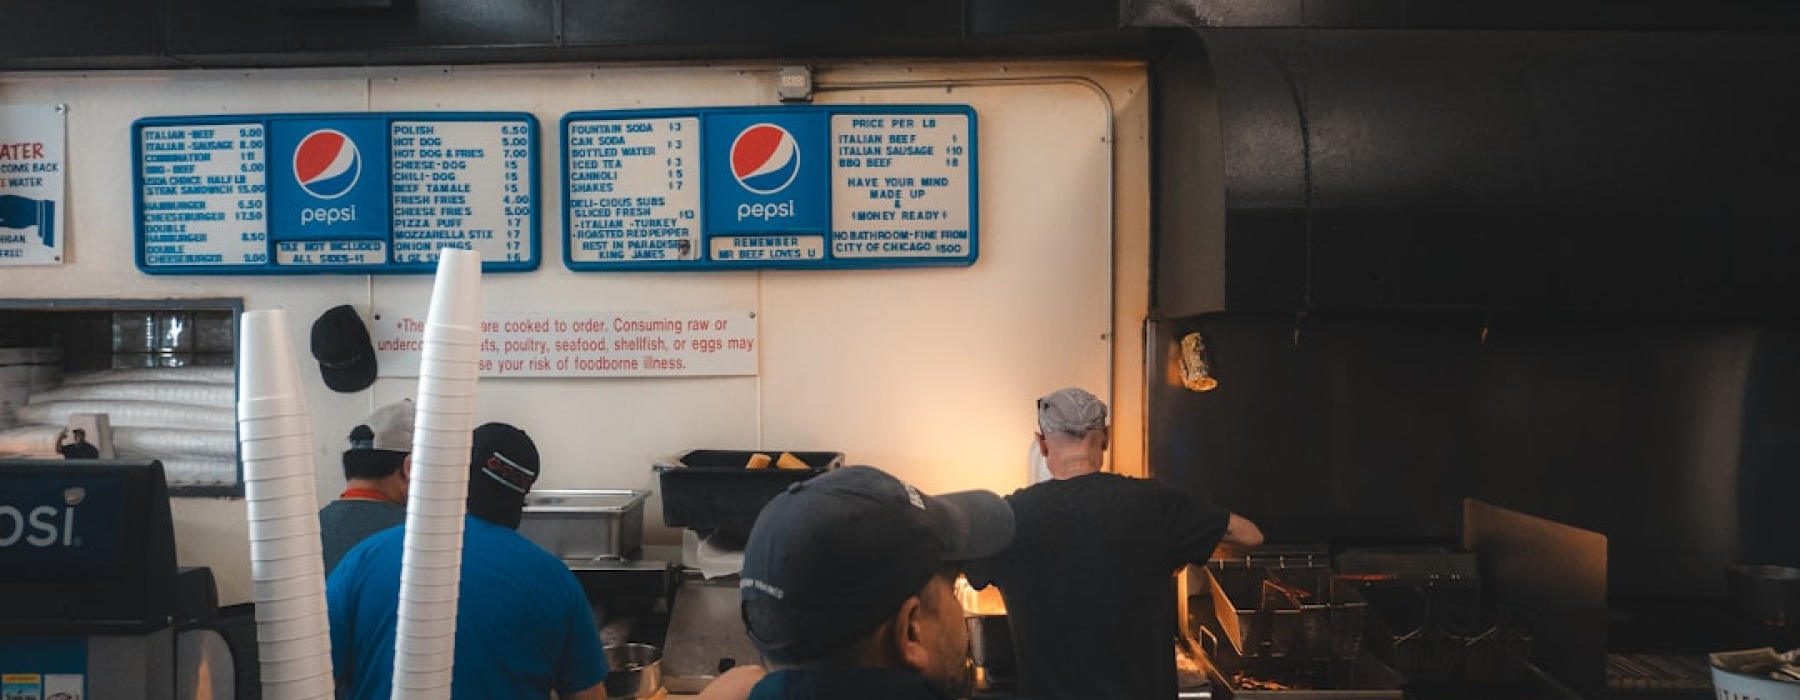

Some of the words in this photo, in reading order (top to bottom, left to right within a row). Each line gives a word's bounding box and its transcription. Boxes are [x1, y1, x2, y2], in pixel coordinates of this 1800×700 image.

[571, 125, 622, 133] FOUNTAIN
[626, 123, 653, 132] SODA
[852, 120, 884, 128] PRICE
[891, 120, 914, 128] PER
[922, 120, 936, 128] LB
[394, 126, 434, 134] POLISH
[502, 126, 527, 134] 6.50
[145, 131, 186, 140] ITALIAN
[839, 135, 882, 143] ITALIAN
[889, 135, 916, 143] BEEF
[394, 138, 414, 146] HOT
[420, 138, 442, 146] DOG
[502, 138, 527, 146] 5.00
[571, 137, 593, 145] CAN
[598, 136, 625, 145] SODA
[145, 142, 186, 151] ITALIAN
[839, 147, 881, 155] ITALIAN
[886, 147, 934, 155] SAUSAGE
[394, 150, 415, 158] HOT
[420, 150, 442, 158] DOG
[455, 150, 484, 158] FRIES
[504, 150, 527, 158] 7.00
[571, 148, 617, 157] BOTTLED
[622, 146, 656, 155] WATER
[145, 153, 211, 162] COMBINATION
[1, 163, 30, 172] COME
[33, 162, 58, 172] BACK
[573, 160, 598, 168] ICED
[602, 160, 622, 168] TEA
[839, 158, 861, 167] BBQ
[866, 158, 892, 167] BEEF
[169, 177, 201, 185] CHOICE
[207, 175, 232, 183] HALF
[234, 175, 246, 183] LB
[571, 172, 617, 180] CANNOLI
[9, 178, 42, 188] WATER
[847, 178, 878, 187] HAVE
[885, 178, 914, 187] YOUR
[921, 178, 949, 186] MIND
[145, 187, 177, 195] STEAK
[394, 184, 419, 193] BEEF
[427, 184, 471, 193] TAMALE
[571, 183, 613, 192] SHAKES
[869, 190, 902, 198] MADE
[909, 190, 926, 198] UP
[395, 196, 430, 204] FRESH
[435, 196, 465, 204] FRIES
[502, 195, 529, 204] 4.00
[636, 197, 666, 206] SUBS
[144, 202, 205, 210] HAMBURGER
[737, 200, 794, 221] pepsi
[301, 205, 356, 226] pepsi
[394, 207, 435, 216] CHEESE
[441, 207, 473, 216] FRIES
[505, 207, 530, 216] 5.00
[575, 209, 611, 217] SLICED
[616, 208, 651, 217] FRESH
[144, 213, 225, 221] CHEESEBURGER
[394, 219, 430, 227] PIZZA
[437, 219, 462, 227] PUFF
[145, 234, 207, 242] HAMBURGER
[395, 230, 465, 239] MOZZARELLA
[468, 230, 493, 239] STIX
[833, 232, 848, 240] NO
[941, 230, 968, 239] FROM
[281, 242, 298, 251] TAX
[305, 242, 324, 251] NOT
[329, 242, 380, 251] INCLUDED
[396, 242, 431, 250] ONION
[436, 241, 472, 250] RINGS
[582, 241, 608, 250] REST
[612, 241, 624, 250] IN
[734, 238, 799, 247] REMEMBER
[836, 243, 862, 252] CITY
[866, 243, 880, 252] OF
[883, 242, 931, 251] CHICAGO
[146, 246, 183, 254] DOUBLE
[600, 250, 624, 259] KING
[632, 250, 665, 258] JAMES
[719, 250, 734, 259] MR
[740, 250, 765, 259] BEEF
[769, 250, 801, 258] LOVES
[807, 248, 816, 258] U
[147, 255, 222, 263] CHEESEBURGER
[293, 254, 311, 262] ALL
[481, 321, 499, 332] are
[504, 318, 549, 332] cooked
[554, 318, 567, 332] to
[573, 317, 608, 332] order.
[613, 317, 682, 334] Consuming
[688, 319, 709, 331] raw
[715, 318, 728, 331] or
[377, 337, 423, 351] underco
[504, 338, 550, 354] poultry,
[554, 337, 609, 352] seafood,
[673, 338, 686, 351] or
[692, 338, 722, 352] eggs
[728, 337, 754, 352] may
[498, 359, 524, 373] your
[529, 357, 551, 371] risk
[556, 357, 568, 371] of
[574, 356, 638, 371] foodborne
[643, 355, 686, 370] illness.
